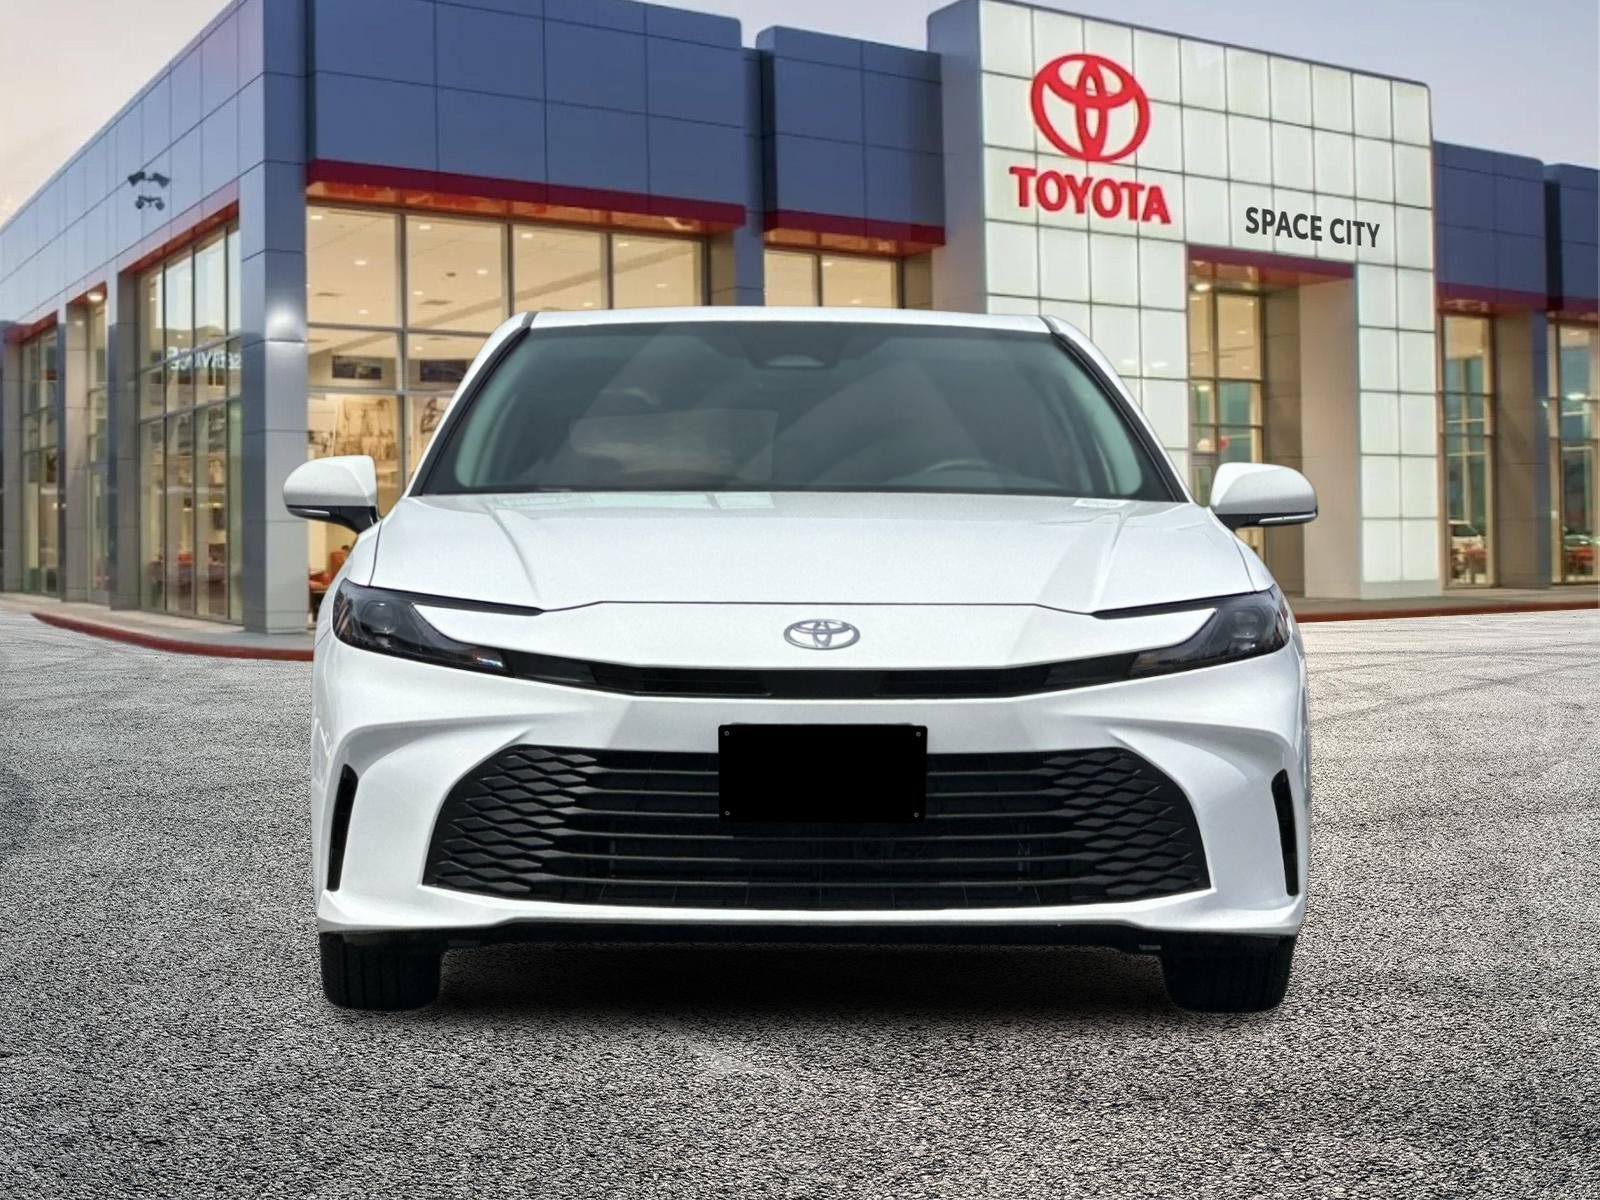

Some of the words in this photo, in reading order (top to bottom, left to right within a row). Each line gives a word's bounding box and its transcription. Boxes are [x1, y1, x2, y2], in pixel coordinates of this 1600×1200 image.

[1009, 166, 1171, 225] TOYOTA
[1245, 206, 1323, 242] SPACE
[1329, 218, 1381, 248] CITY
